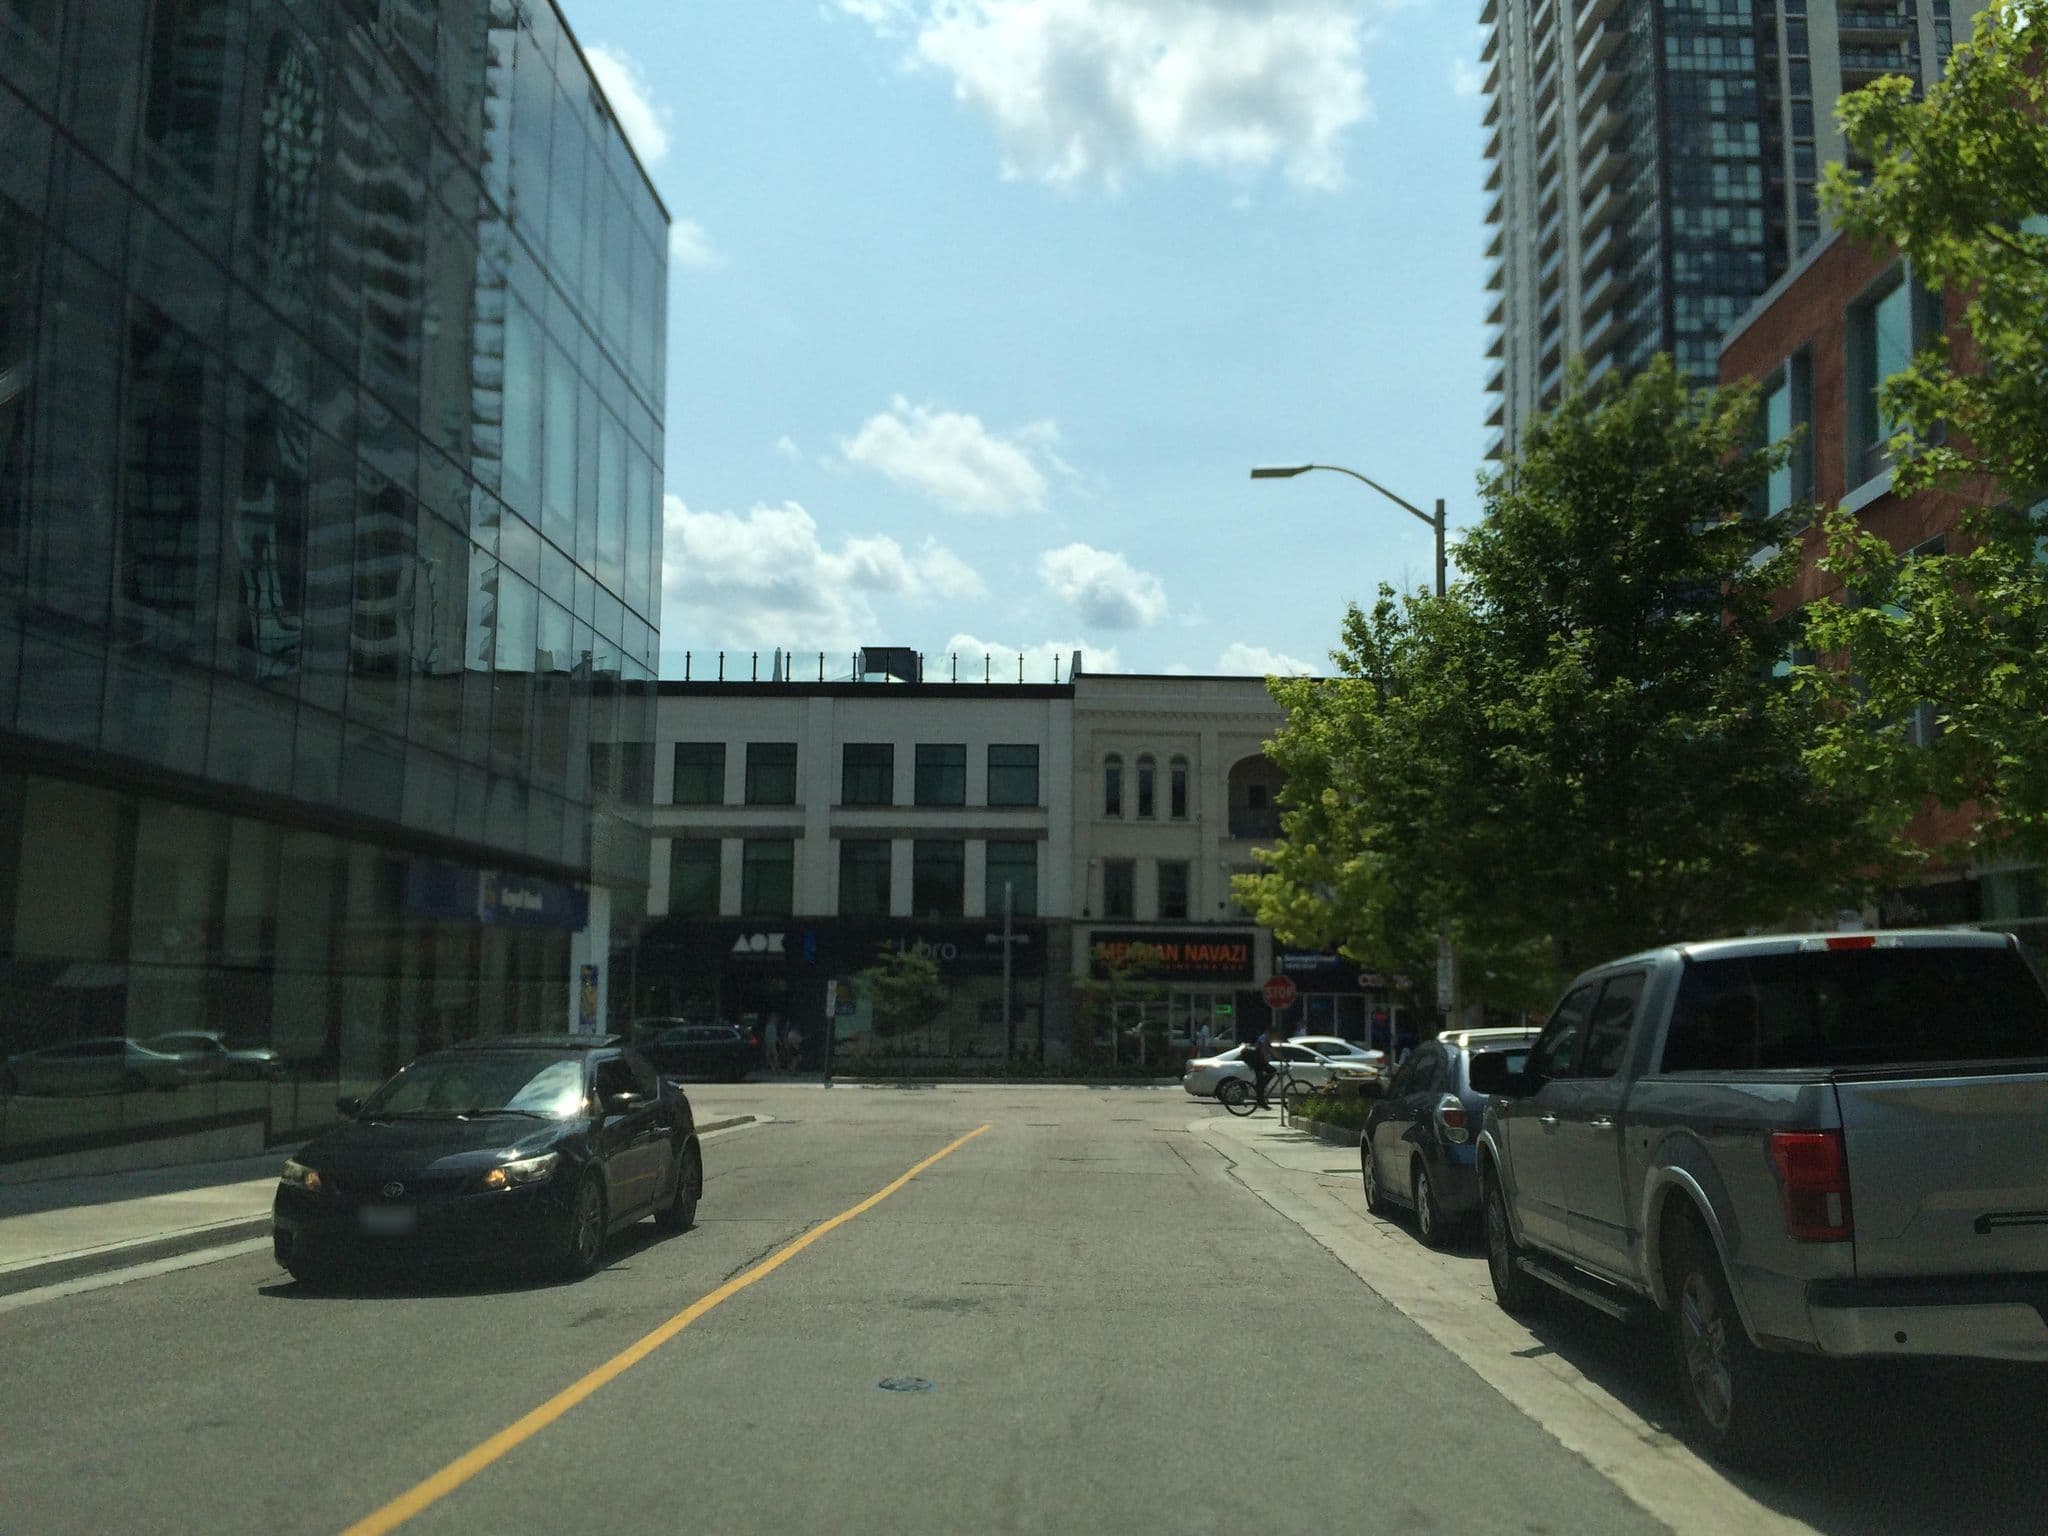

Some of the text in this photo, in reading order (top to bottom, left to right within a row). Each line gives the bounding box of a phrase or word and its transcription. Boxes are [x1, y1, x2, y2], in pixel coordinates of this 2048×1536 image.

[899, 936, 957, 960] Lbro
[1184, 943, 1247, 961] NAVAZI
[1264, 985, 1293, 999] STOP
